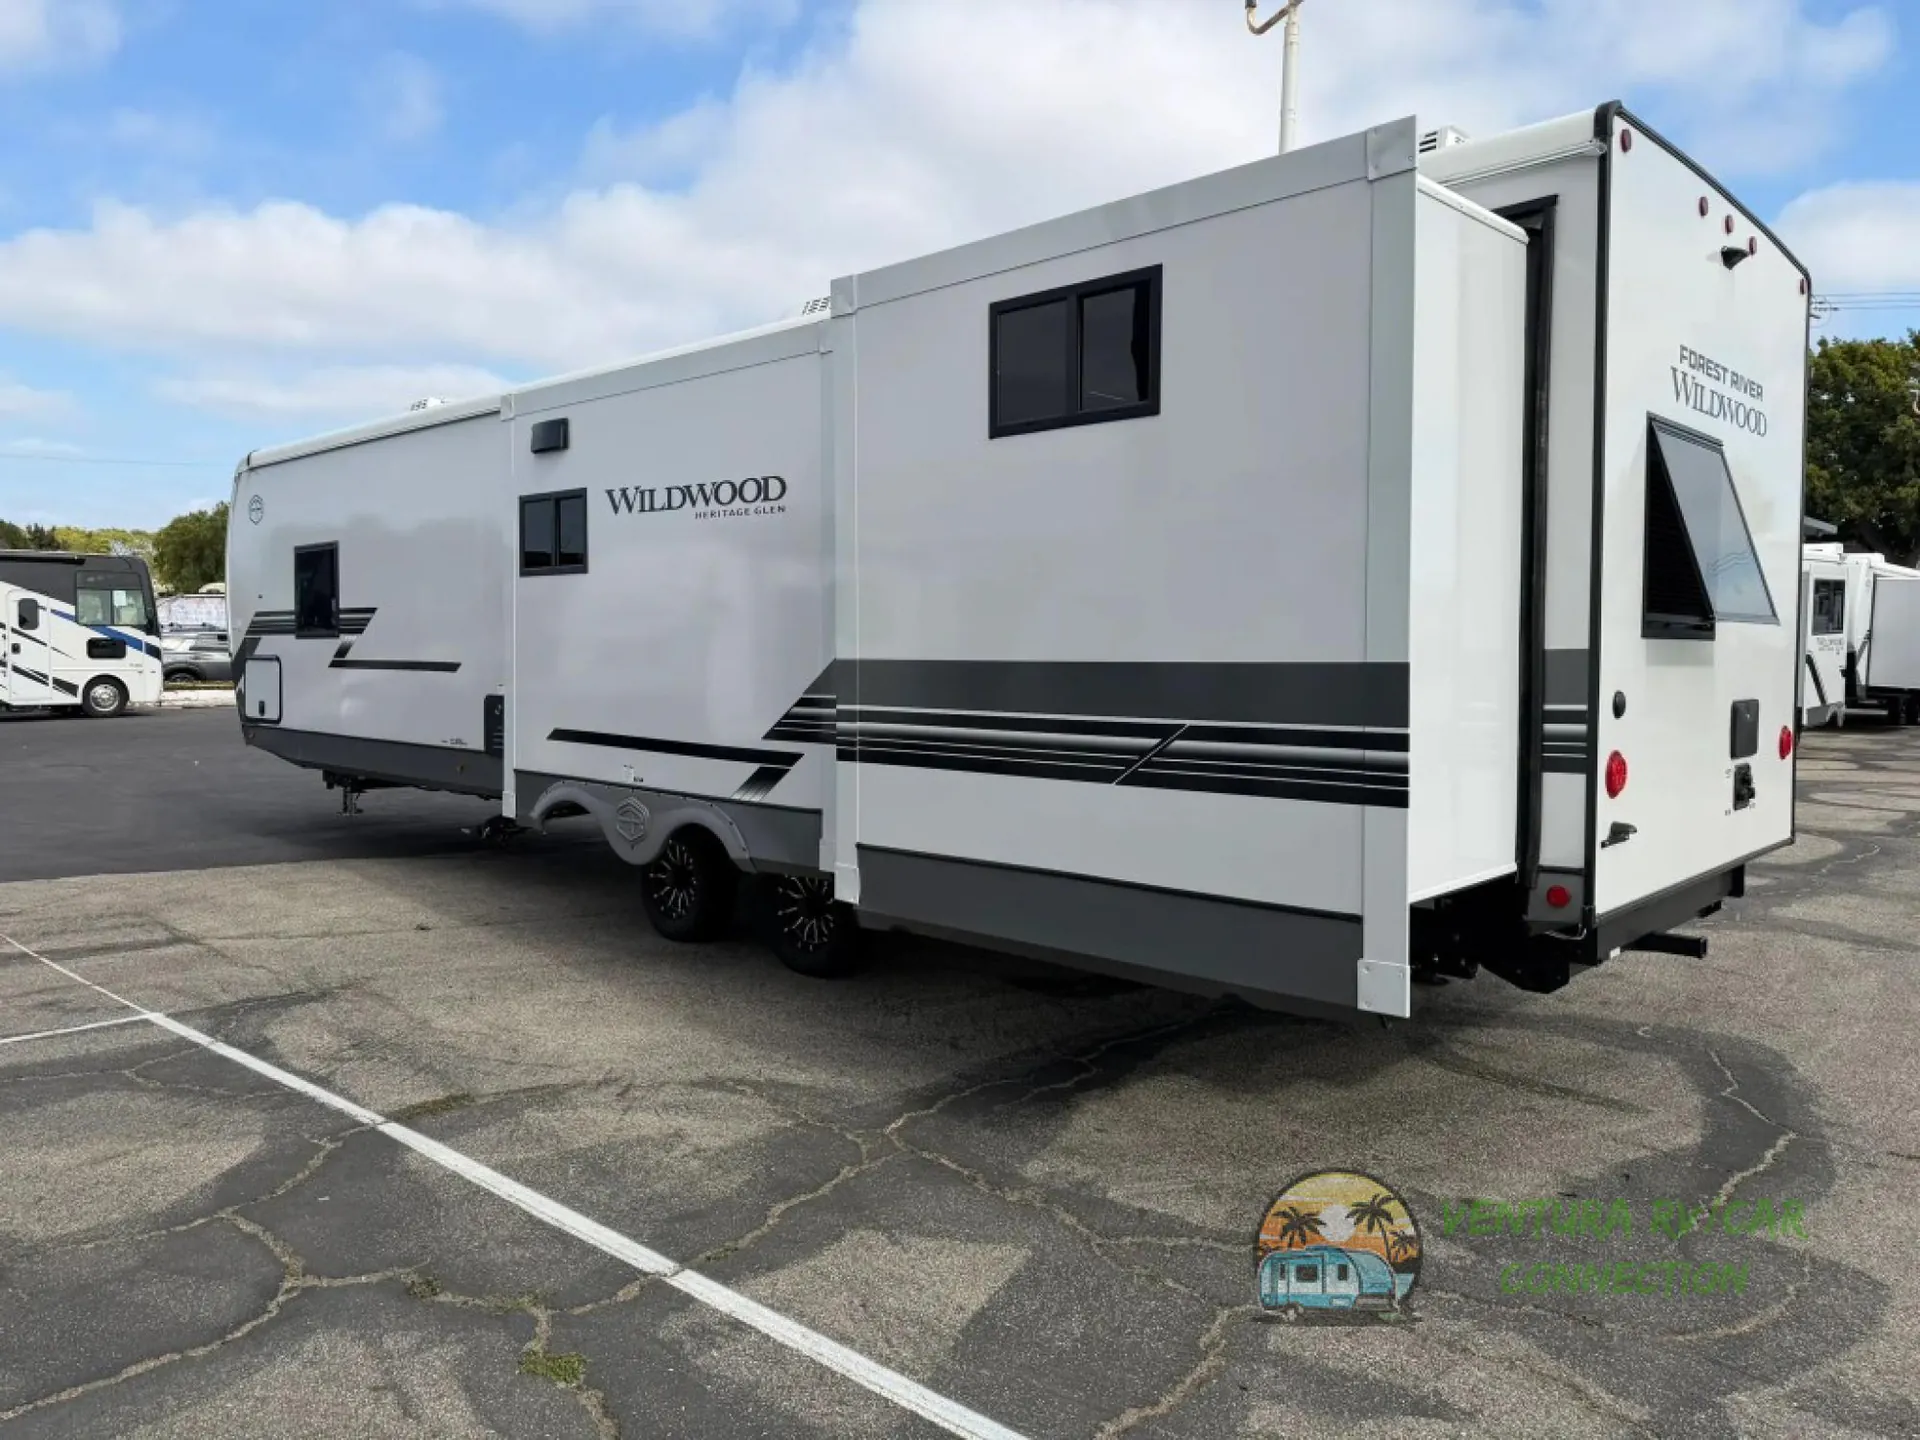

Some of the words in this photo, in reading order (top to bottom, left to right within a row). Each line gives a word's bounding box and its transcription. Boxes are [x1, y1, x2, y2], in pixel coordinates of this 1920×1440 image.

[1679, 344, 1729, 385] FOREST
[1730, 370, 1763, 402] RIVER
[1670, 365, 1767, 438] WILDWOOD
[605, 475, 787, 516] WILDWOOD
[695, 507, 751, 519] HERITAGE
[753, 505, 786, 515] GLEN
